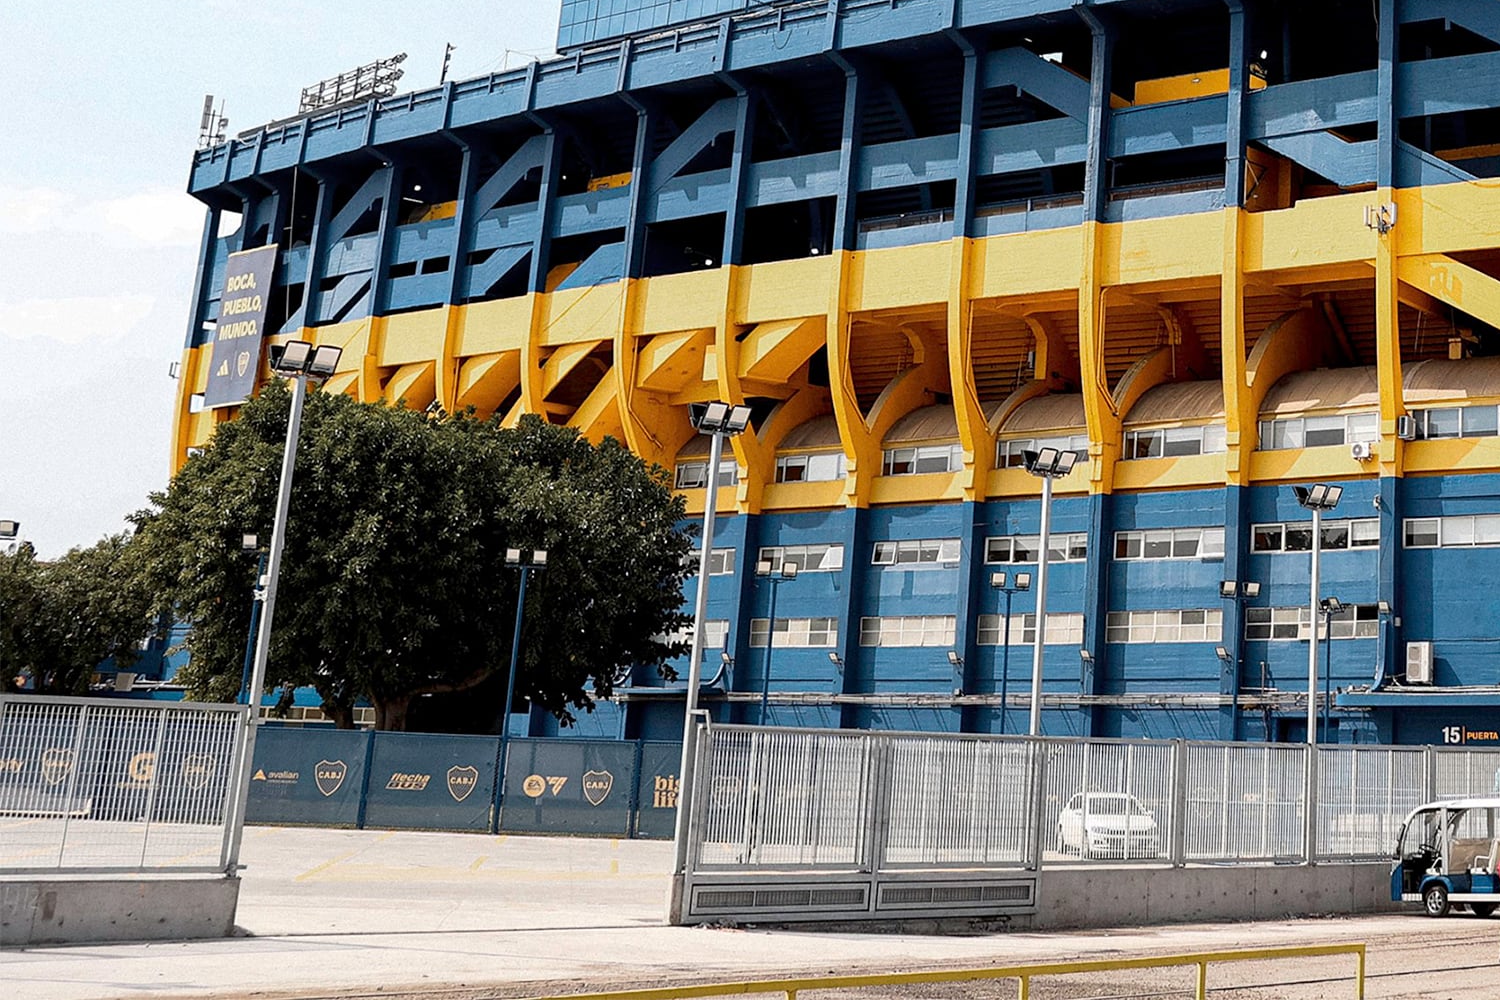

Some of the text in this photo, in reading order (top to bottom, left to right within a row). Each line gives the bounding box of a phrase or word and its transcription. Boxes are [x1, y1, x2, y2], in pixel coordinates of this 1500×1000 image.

[227, 273, 256, 292] BOCA,
[223, 295, 262, 316] PUEBLO,
[219, 320, 257, 340] MUNDO.
[1442, 726, 1499, 744] 15 PUERTA
[318, 771, 342, 779] CABJ
[450, 777, 474, 785] CABJ
[586, 781, 609, 789] CABJ
